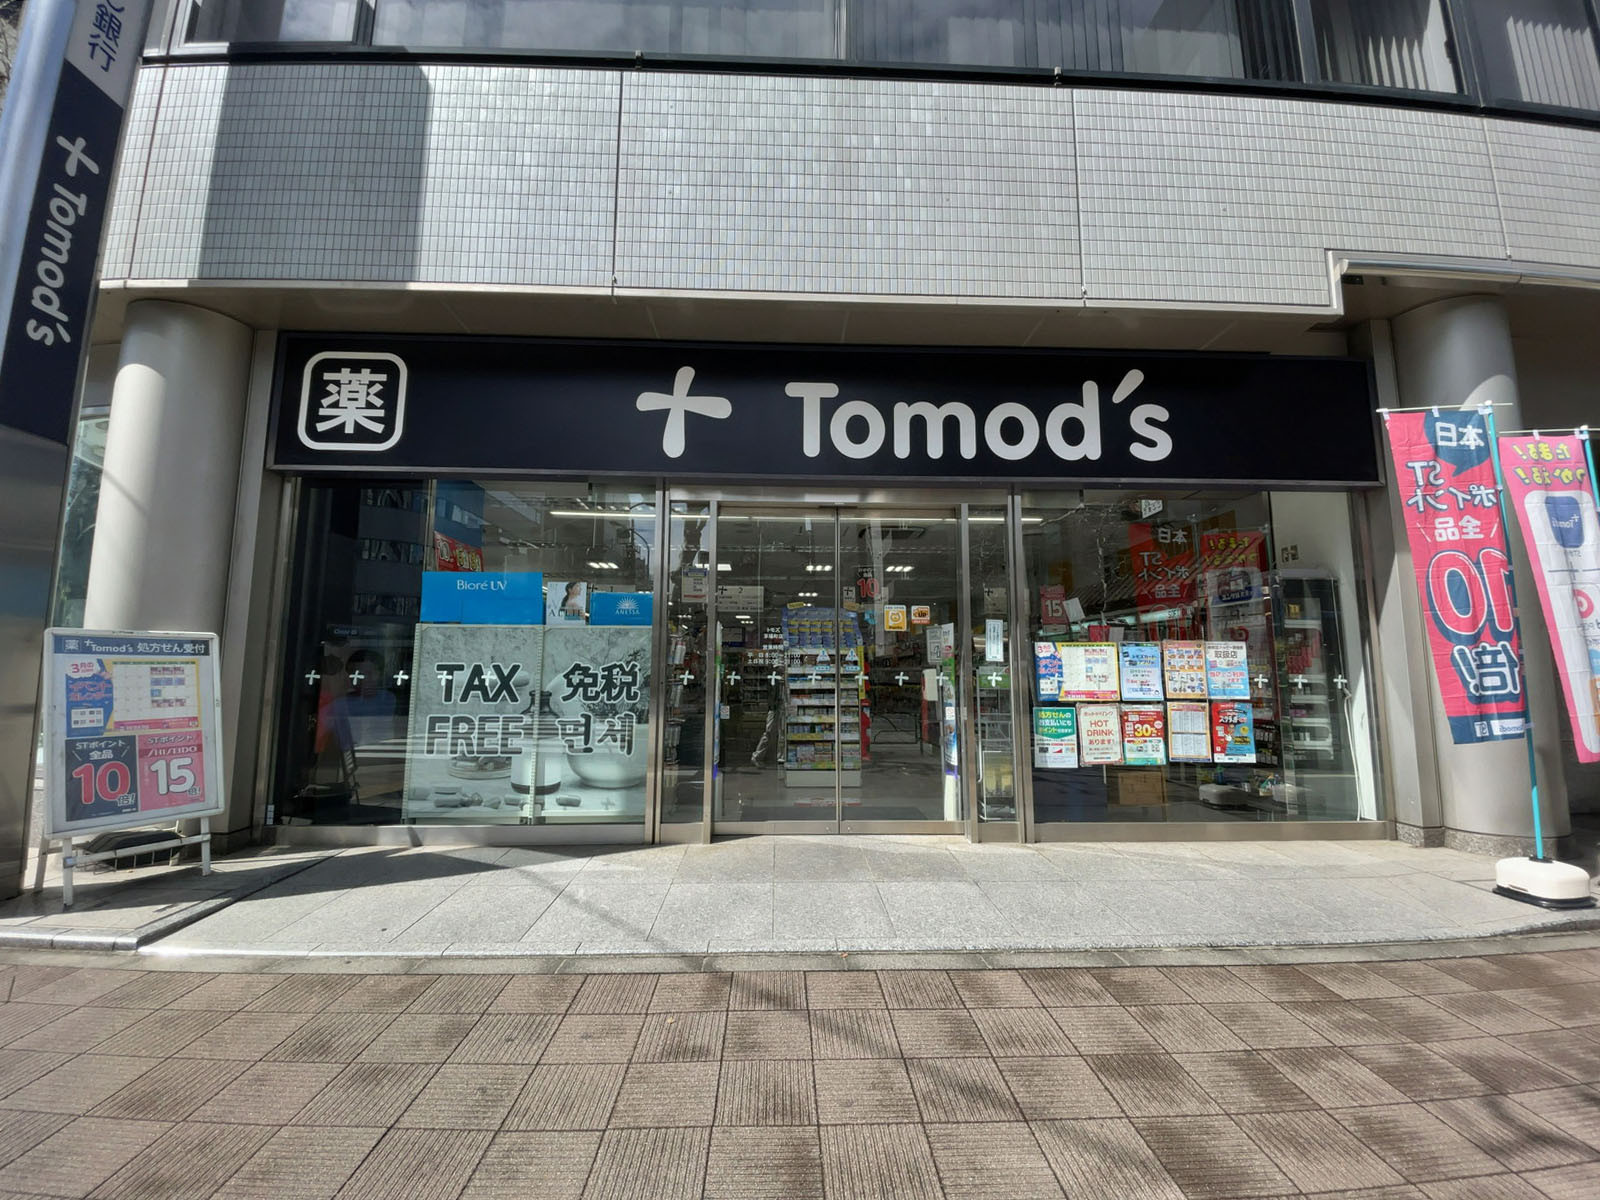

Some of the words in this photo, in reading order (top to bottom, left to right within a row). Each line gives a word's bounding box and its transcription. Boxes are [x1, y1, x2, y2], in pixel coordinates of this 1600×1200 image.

[26, 183, 87, 346] Tomod's
[315, 367, 388, 434] 薬
[784, 368, 1173, 462] Tomod's
[456, 579, 489, 591] Bioré
[490, 580, 507, 591] UV
[1045, 600, 1063, 617] 15
[91, 643, 133, 653] Tomod's
[137, 642, 205, 654] 処方せん受付
[435, 663, 522, 703] TAX
[560, 662, 640, 703] 免税
[424, 714, 524, 757] FREE
[556, 712, 636, 756] 면세
[1086, 729, 1115, 737] DRINK
[1090, 720, 1109, 728] HOT
[75, 739, 128, 750] STポイント
[89, 749, 114, 760] 全品
